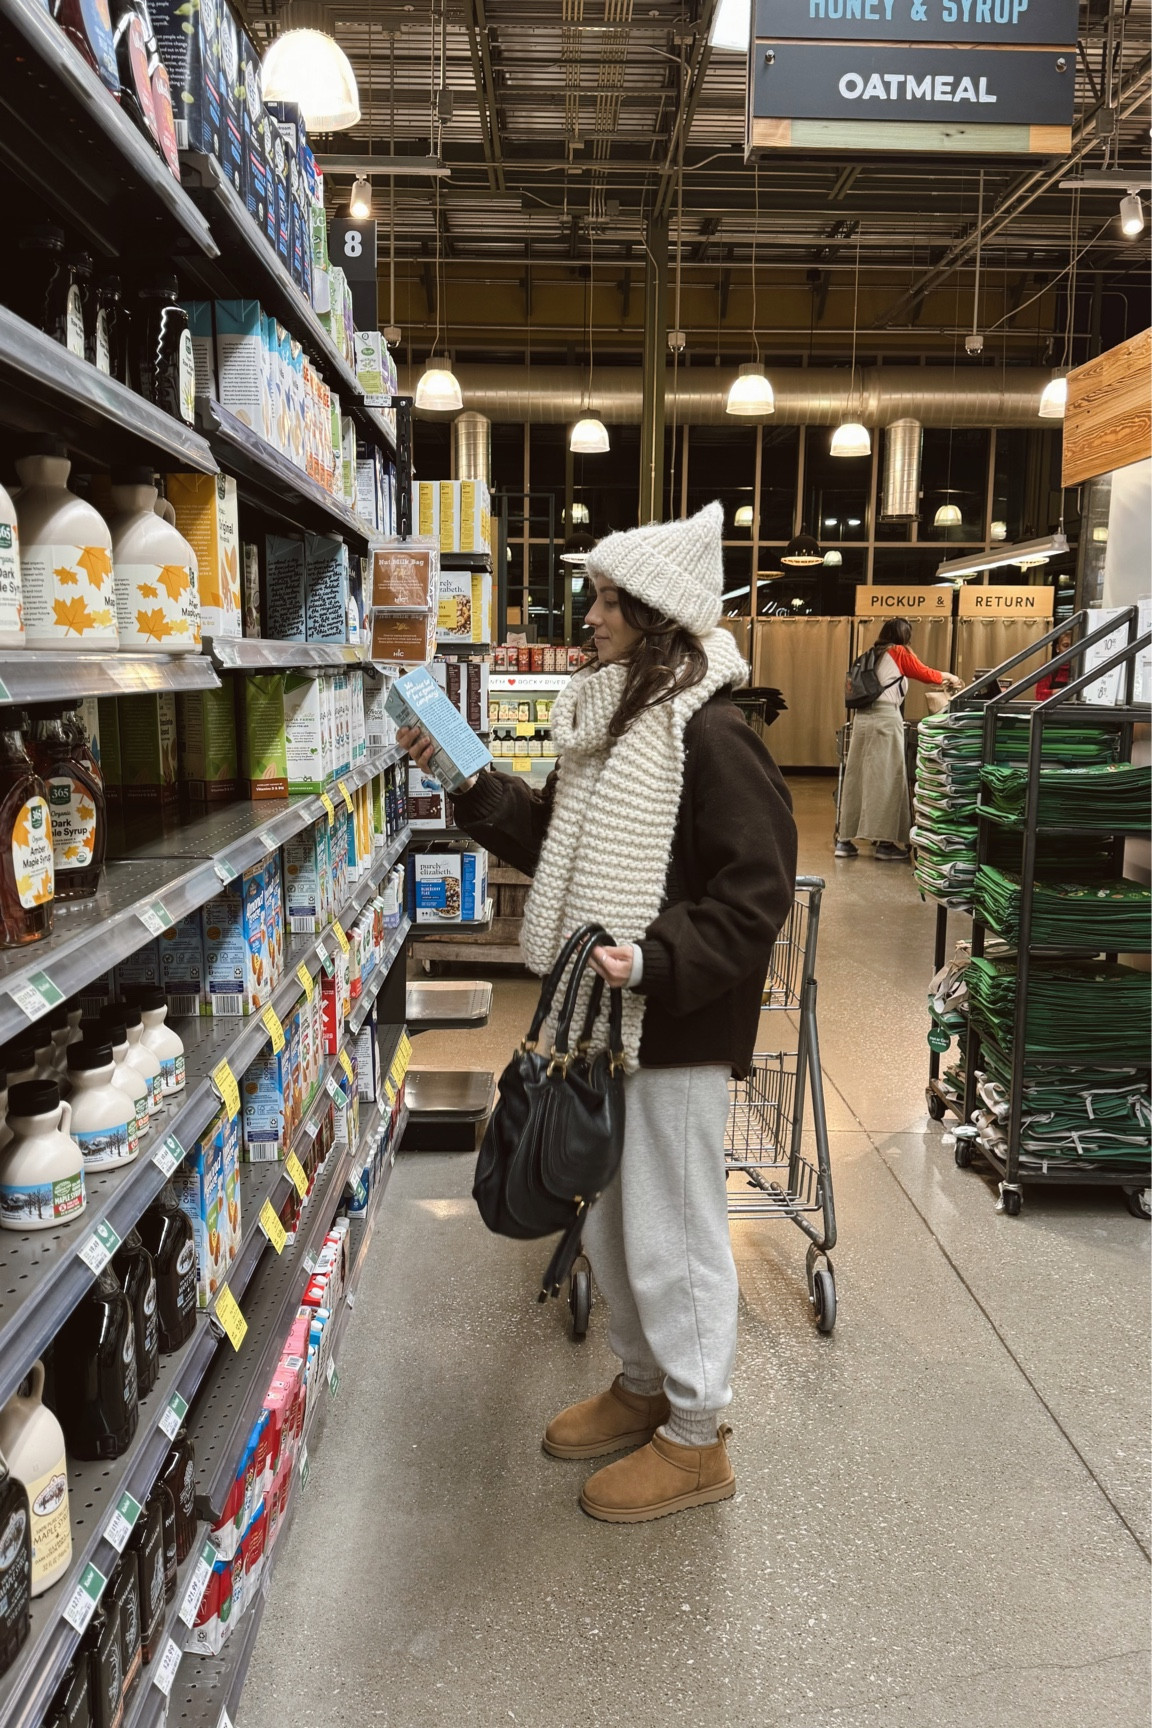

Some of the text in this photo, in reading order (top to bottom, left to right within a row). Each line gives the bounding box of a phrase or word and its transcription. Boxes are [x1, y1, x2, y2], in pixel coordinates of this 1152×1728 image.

[809, 0, 1029, 24] HONEY & SYRUP
[839, 72, 997, 103] OATMEAL
[344, 230, 362, 257] 8
[0, 526, 10, 540] 65
[440, 580, 452, 588] rely
[871, 595, 945, 608] PICKUP &
[976, 596, 1035, 608] RETURN
[52, 788, 69, 798] 365
[52, 819, 72, 828] Dark
[64, 828, 88, 838] Syrup
[30, 846, 46, 856] Amber
[22, 856, 40, 869] Maple
[34, 1526, 57, 1546] MAPLE
[84, 1570, 94, 1588] Kosher
